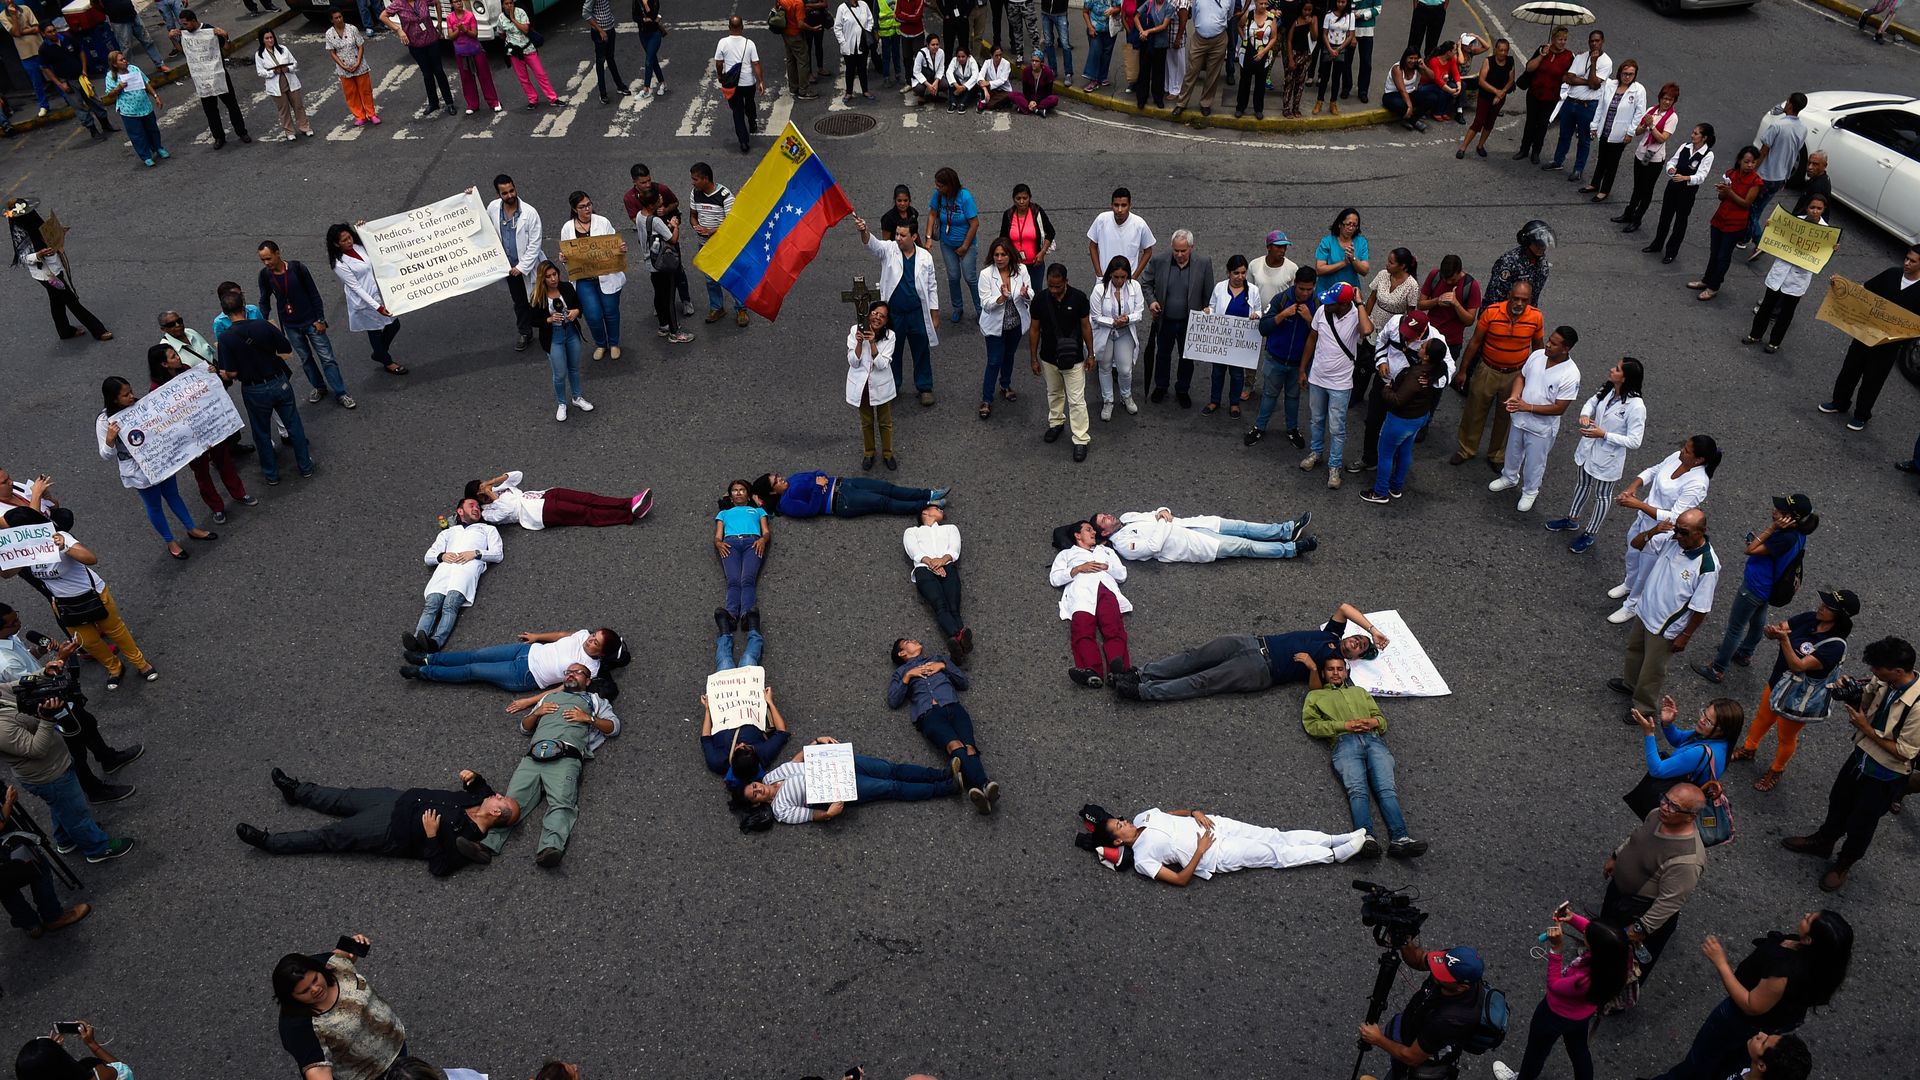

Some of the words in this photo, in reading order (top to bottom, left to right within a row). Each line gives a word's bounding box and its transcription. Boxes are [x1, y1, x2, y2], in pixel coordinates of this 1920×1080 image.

[1783, 217, 1806, 235] SALUD
[379, 236, 426, 255] Familiares
[433, 217, 475, 238] Pacientes
[1773, 226, 1785, 238] EN
[1789, 233, 1822, 254] CRISIS
[406, 236, 464, 261] Venezolanos
[390, 282, 406, 295] por
[409, 270, 444, 287] sueldos
[447, 264, 459, 274] de
[1191, 312, 1230, 326] TENEMOS
[1187, 333, 1233, 347] CONDICIONES
[1235, 339, 1259, 351] DIGNAS
[1235, 329, 1245, 339] EN
[1187, 342, 1193, 351] Y
[1194, 343, 1228, 357] SEGURAS
[173, 391, 185, 402] EN
[0, 551, 14, 561] no
[13, 547, 36, 560] hay
[36, 541, 55, 554] vida
